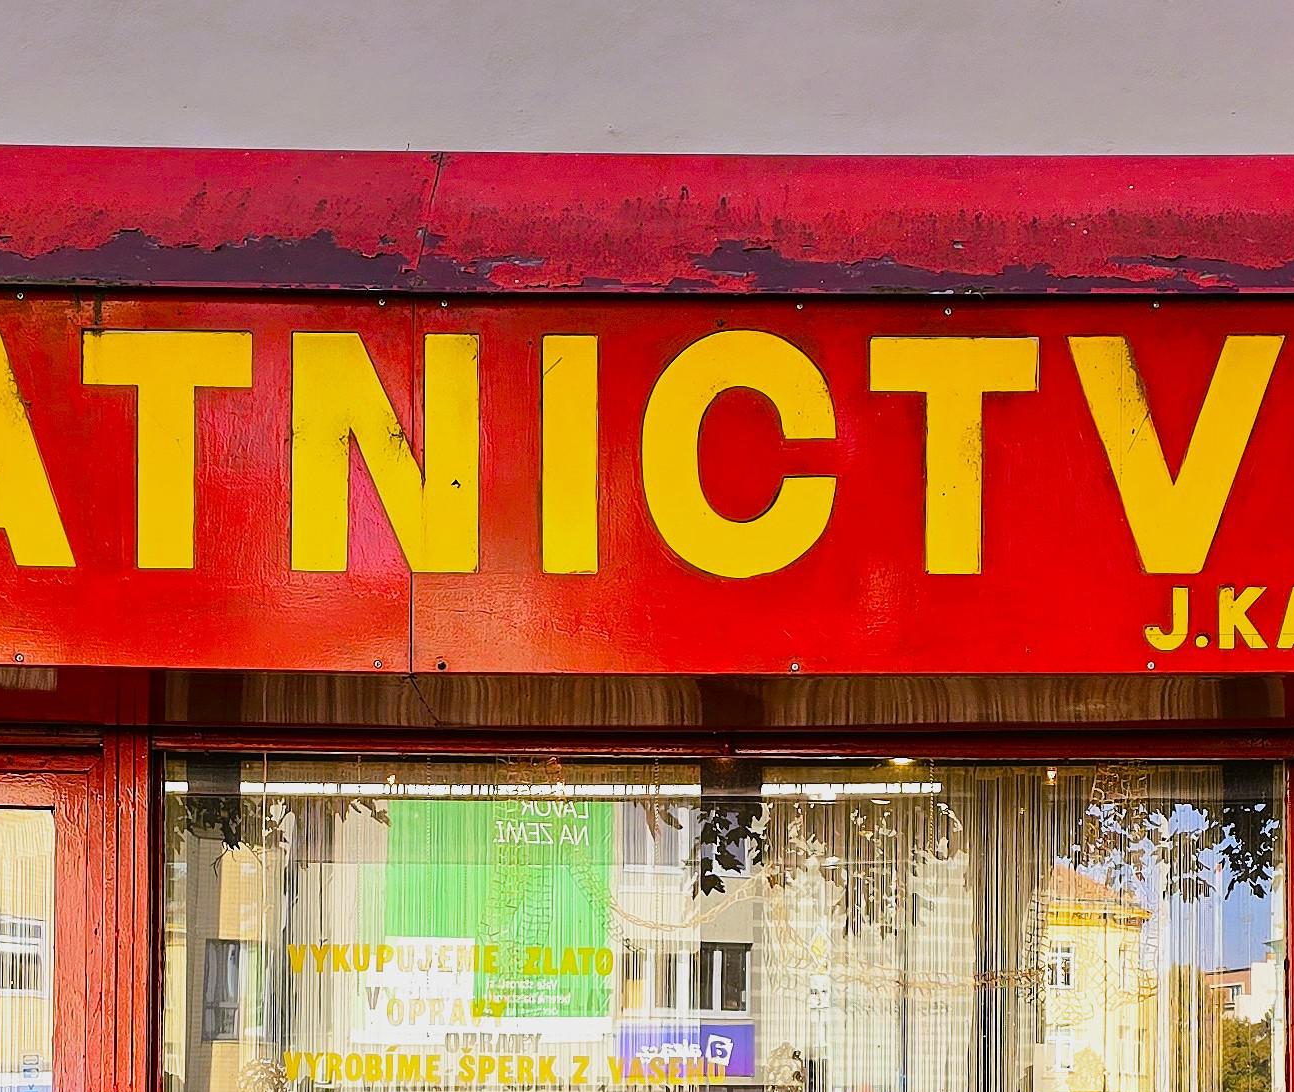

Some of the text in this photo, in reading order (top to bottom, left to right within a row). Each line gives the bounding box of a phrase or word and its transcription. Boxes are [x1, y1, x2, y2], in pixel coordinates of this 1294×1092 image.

[522, 945, 614, 976] ZLATO
[386, 997, 509, 1027] OPRAVY
[283, 1044, 442, 1084] VYROBÍME
[458, 1048, 558, 1085] ŠPERK
[572, 1056, 591, 1084] Z
